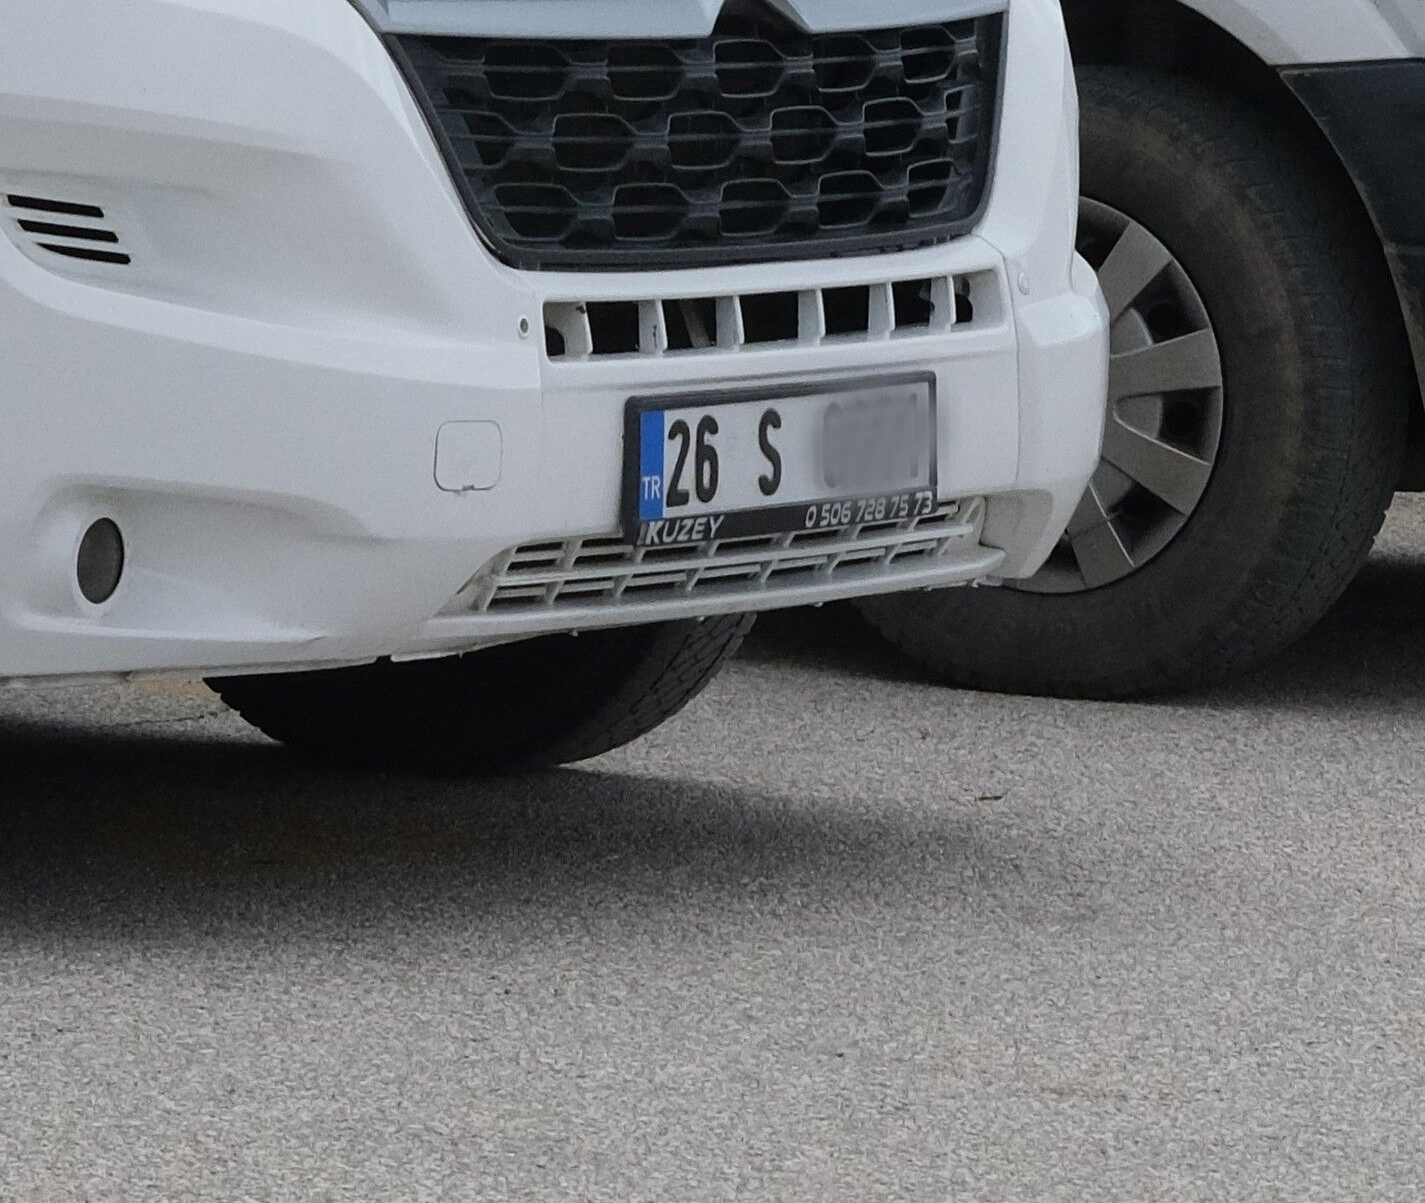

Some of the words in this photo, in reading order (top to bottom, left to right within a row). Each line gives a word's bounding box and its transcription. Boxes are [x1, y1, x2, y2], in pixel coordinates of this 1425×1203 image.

[666, 414, 719, 508] 26
[758, 407, 782, 496] S
[641, 474, 661, 500] TR
[645, 514, 725, 546] KUZEY
[805, 508, 817, 528] 0
[855, 500, 886, 523] 728
[890, 496, 909, 519] 75
[913, 491, 934, 515] 73
